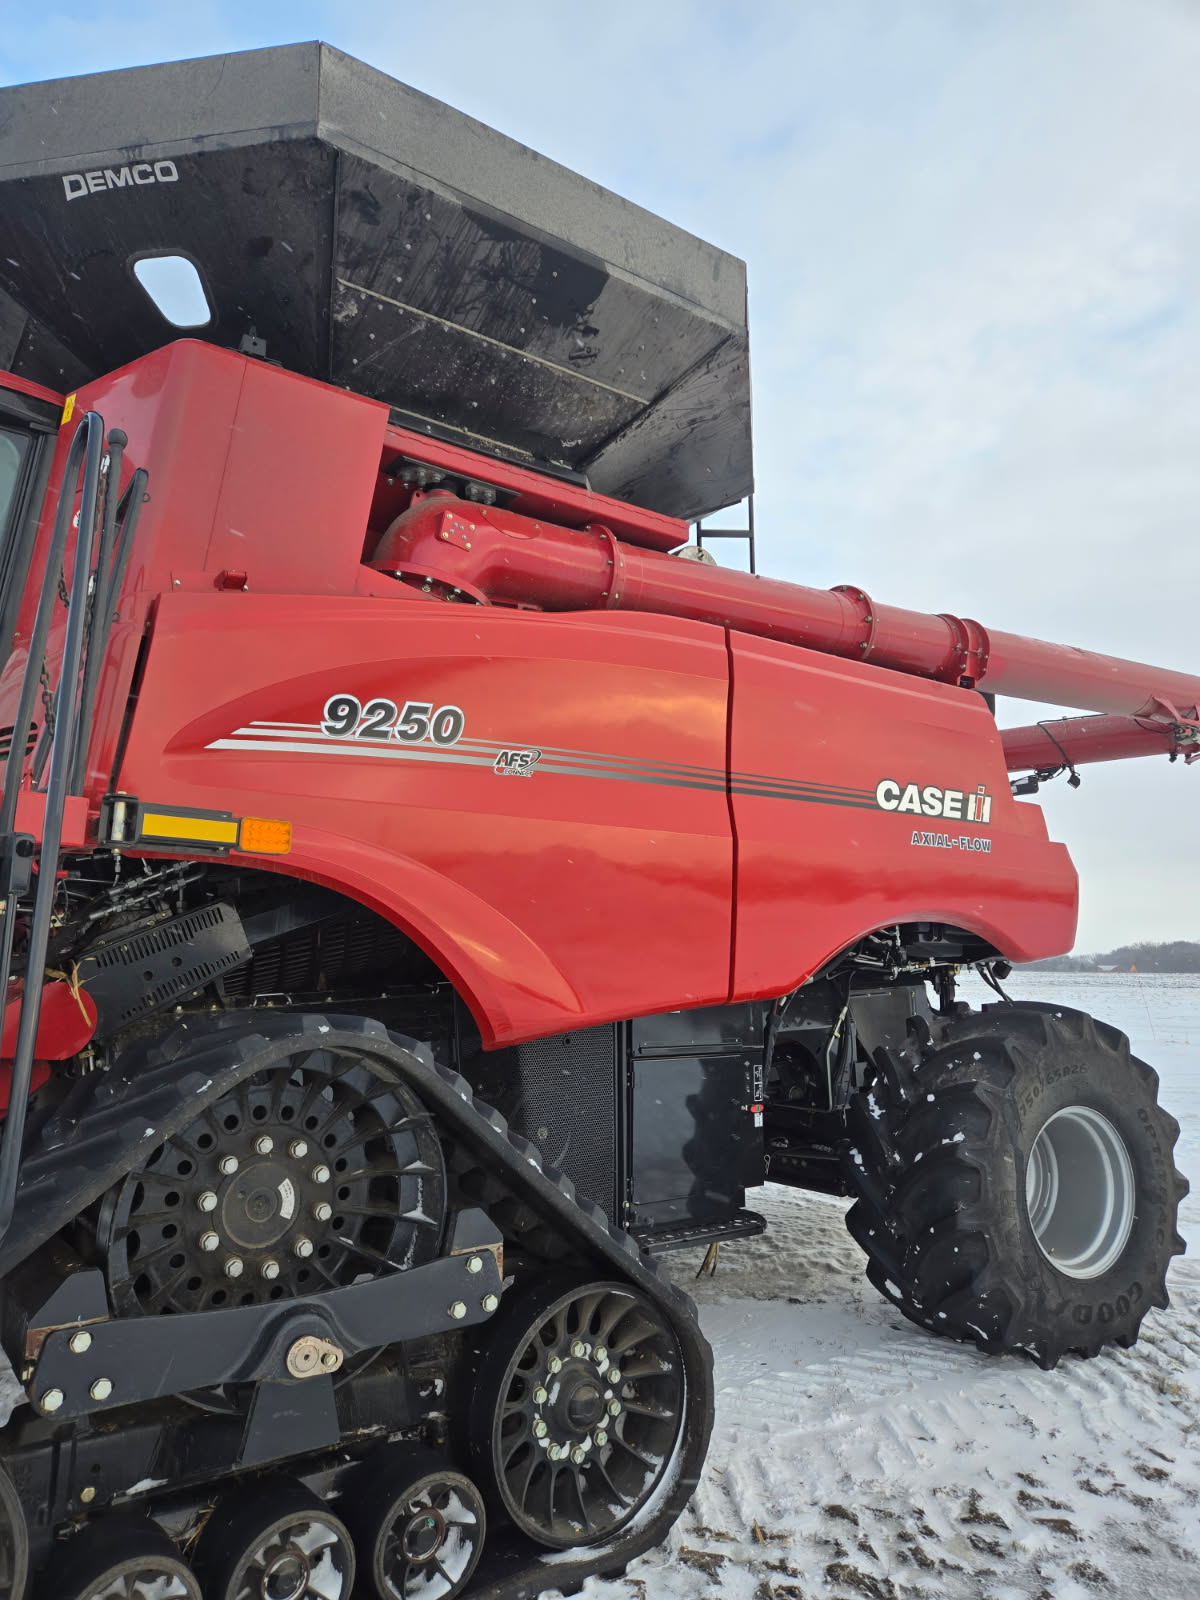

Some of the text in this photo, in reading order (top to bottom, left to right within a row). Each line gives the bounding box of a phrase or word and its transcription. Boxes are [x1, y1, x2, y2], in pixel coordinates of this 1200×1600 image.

[62, 160, 179, 201] DEMCO
[320, 693, 465, 746] 9250
[494, 750, 532, 767] AFS
[876, 779, 963, 819] CASE
[911, 831, 991, 853] AXIAL-FLOW
